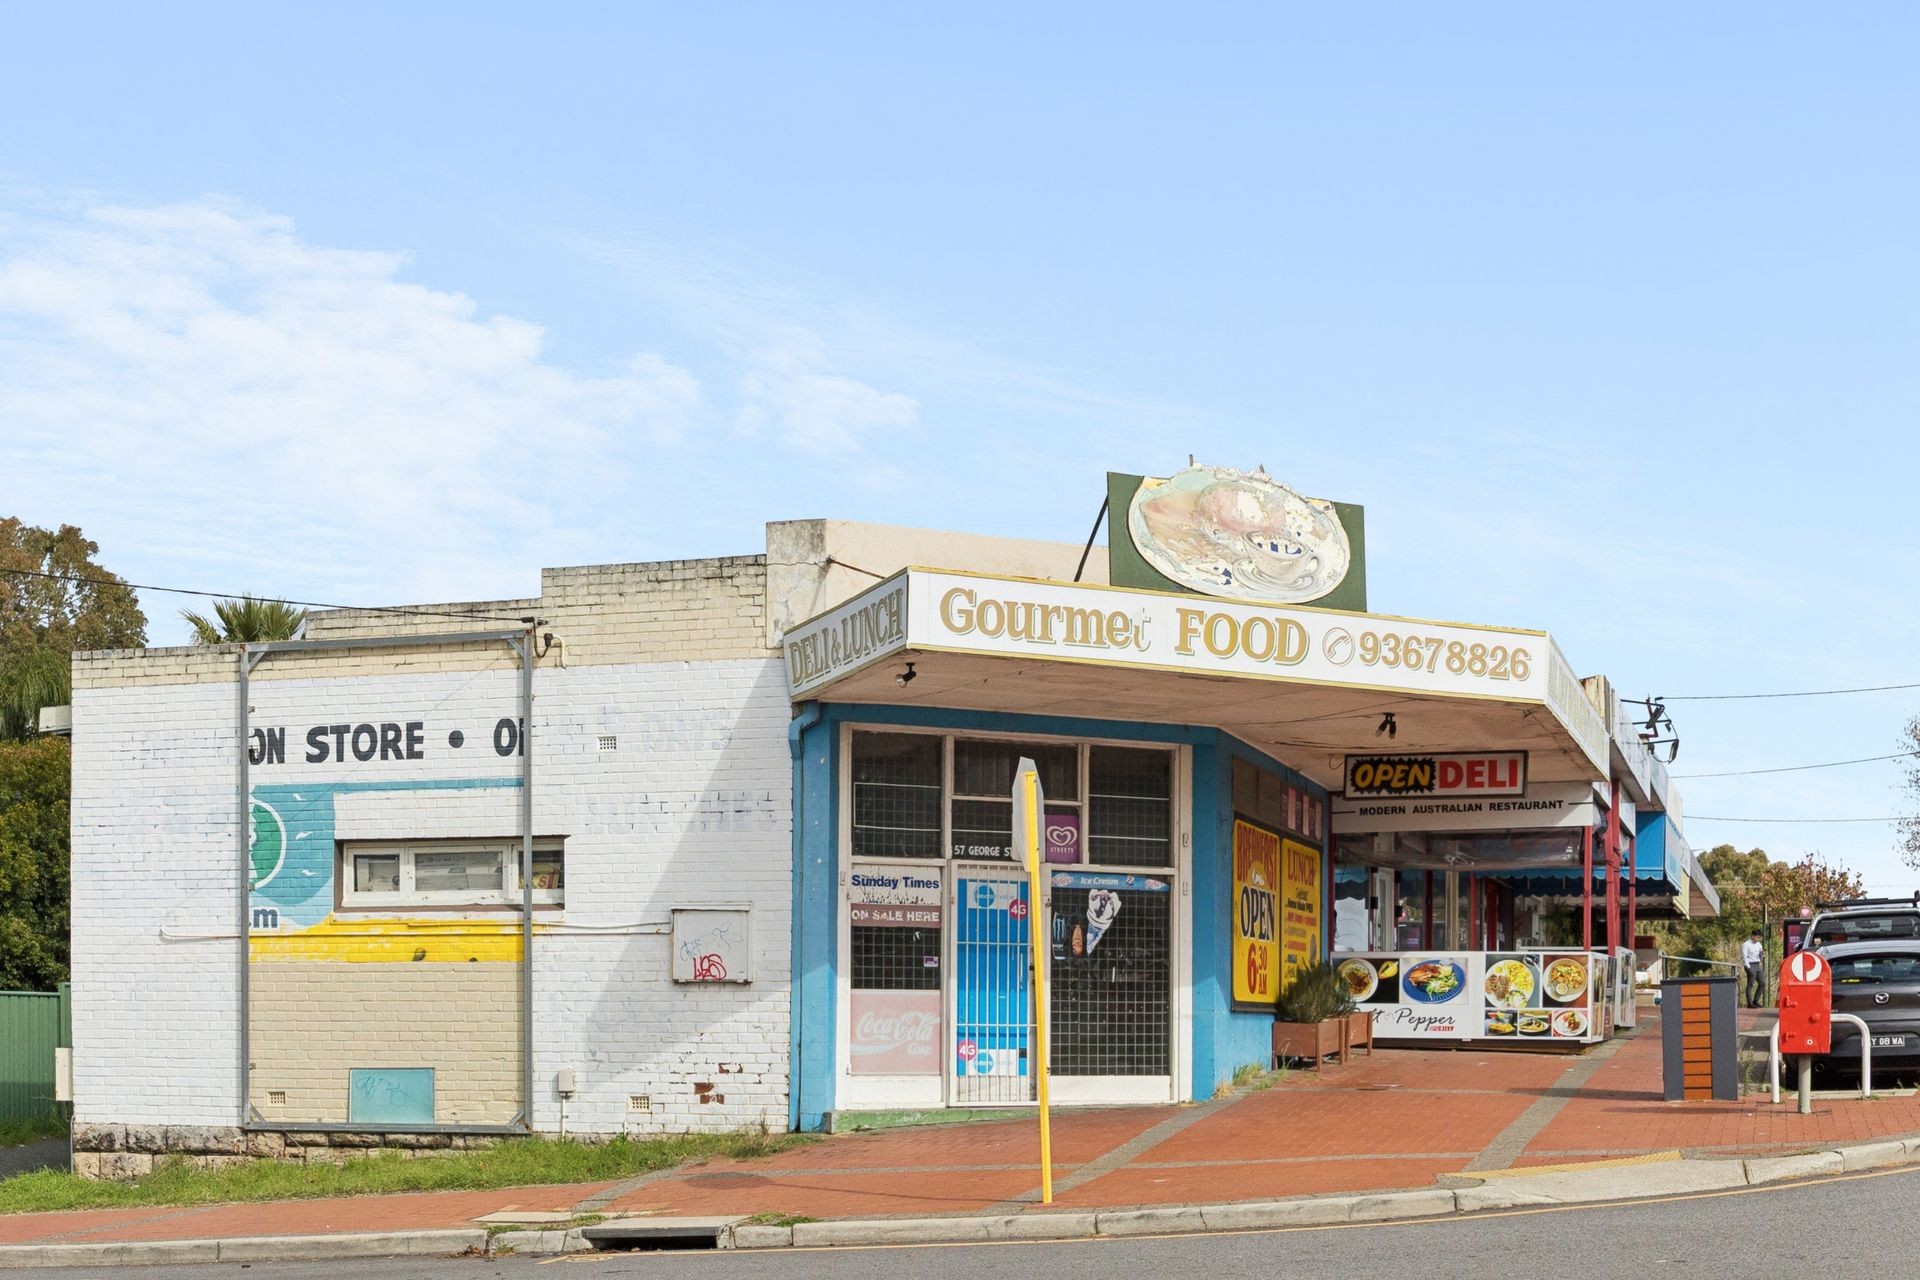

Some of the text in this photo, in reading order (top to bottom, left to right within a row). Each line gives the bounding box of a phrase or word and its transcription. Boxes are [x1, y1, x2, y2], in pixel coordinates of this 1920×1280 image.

[789, 627, 831, 688] DELI
[841, 587, 903, 665] LUNCH
[939, 587, 1532, 682] Gourmet FOOD 93678826
[306, 721, 424, 763] STORE
[493, 718, 524, 757] O
[1354, 759, 1519, 789] OPEN DELI
[1359, 800, 1564, 816] MODERN AUSTRALIAN RESTAURANT
[954, 845, 966, 856] 57
[968, 845, 1000, 857] GEORGE
[1287, 847, 1315, 887] LUNCH
[851, 874, 939, 889] Sunday Times
[1080, 876, 1119, 885] Ice Cream
[851, 909, 940, 922] ON SALE HERE
[1010, 904, 1026, 915] 4G
[1240, 884, 1276, 943] OPEN
[1394, 1007, 1456, 1032] Pepper
[958, 1044, 976, 1056] 4G
